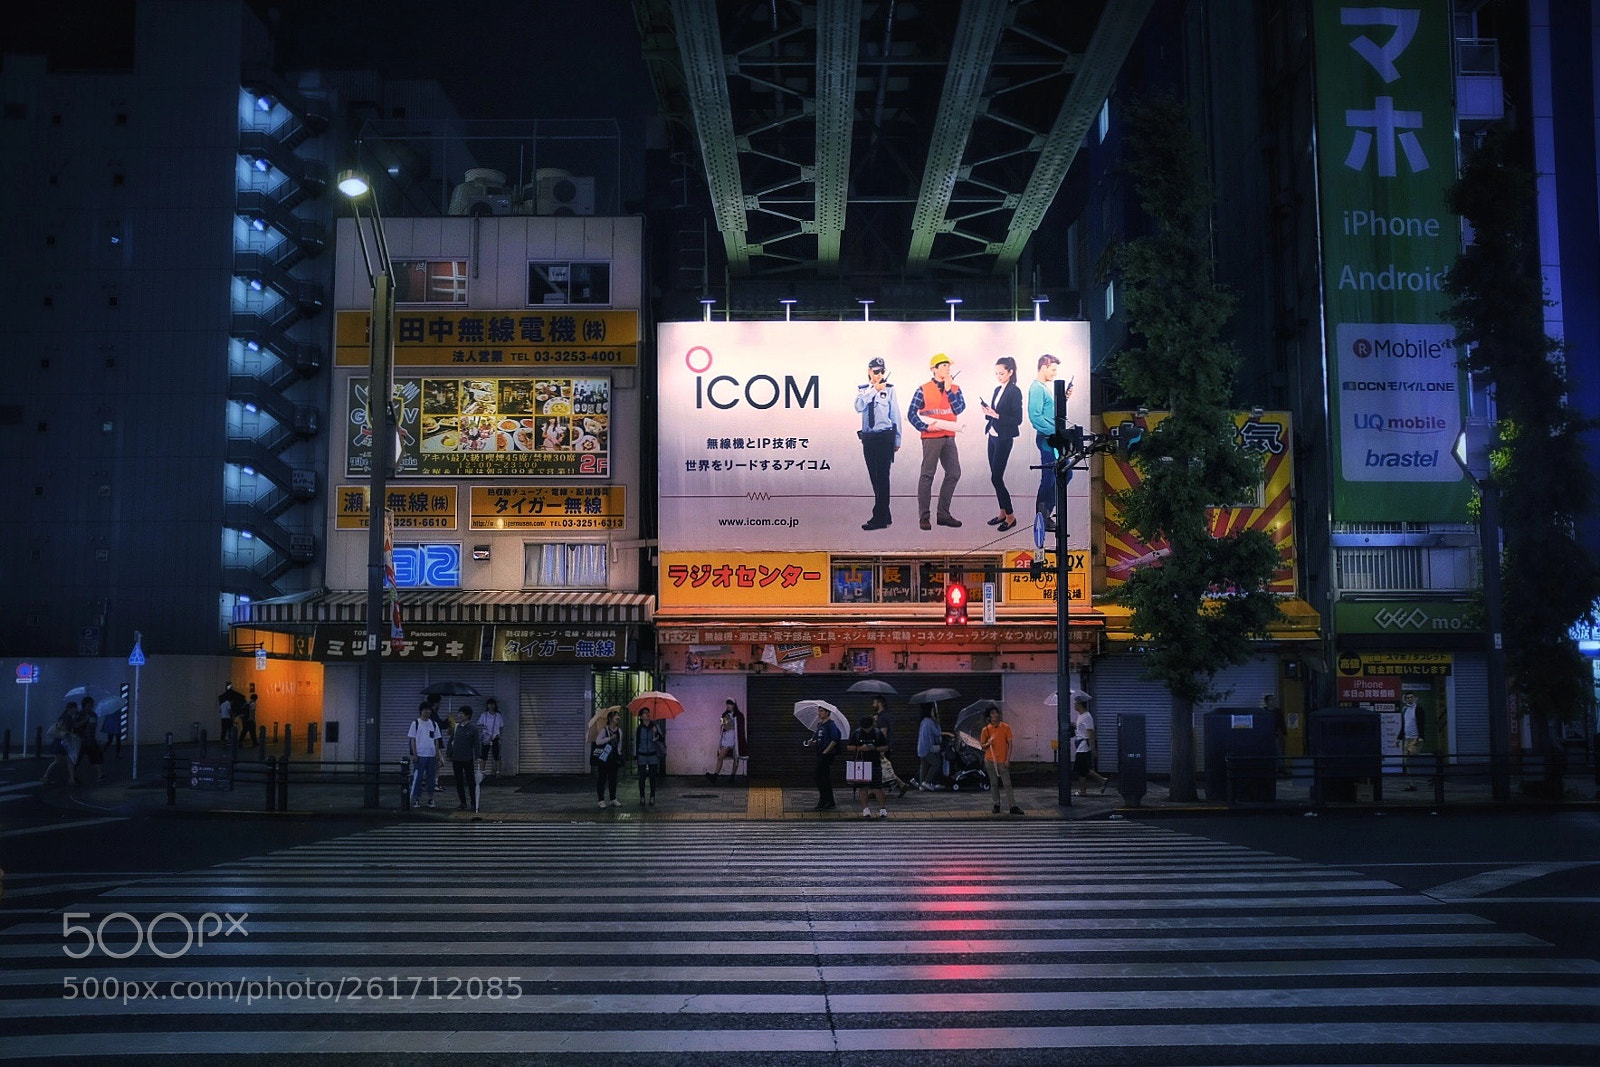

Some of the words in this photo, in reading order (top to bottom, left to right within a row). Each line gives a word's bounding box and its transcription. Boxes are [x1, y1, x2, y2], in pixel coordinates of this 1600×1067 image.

[1343, 209, 1440, 236] iPhone
[1338, 264, 1450, 291] Android
[452, 350, 503, 362] 法人営業
[511, 353, 530, 361] TEL
[1375, 339, 1441, 358] Mobile
[1354, 413, 1384, 431] UQ
[1388, 416, 1446, 429] mobile
[706, 438, 809, 450] 無線機とIP技術で
[580, 454, 607, 474] 2F
[685, 459, 830, 471] 世界をリードするアイコム
[1365, 449, 1439, 467] brastel
[343, 492, 448, 512] 瀬無線(株)
[494, 497, 602, 514] タイガー無線
[719, 517, 799, 528] www.icom.co.jp
[668, 564, 820, 588] ラジオセンター
[1374, 608, 1429, 629] GEO
[504, 639, 616, 657] タイガー無線
[1368, 665, 1447, 674] 現金買取いたします
[1354, 680, 1384, 689] iPhone
